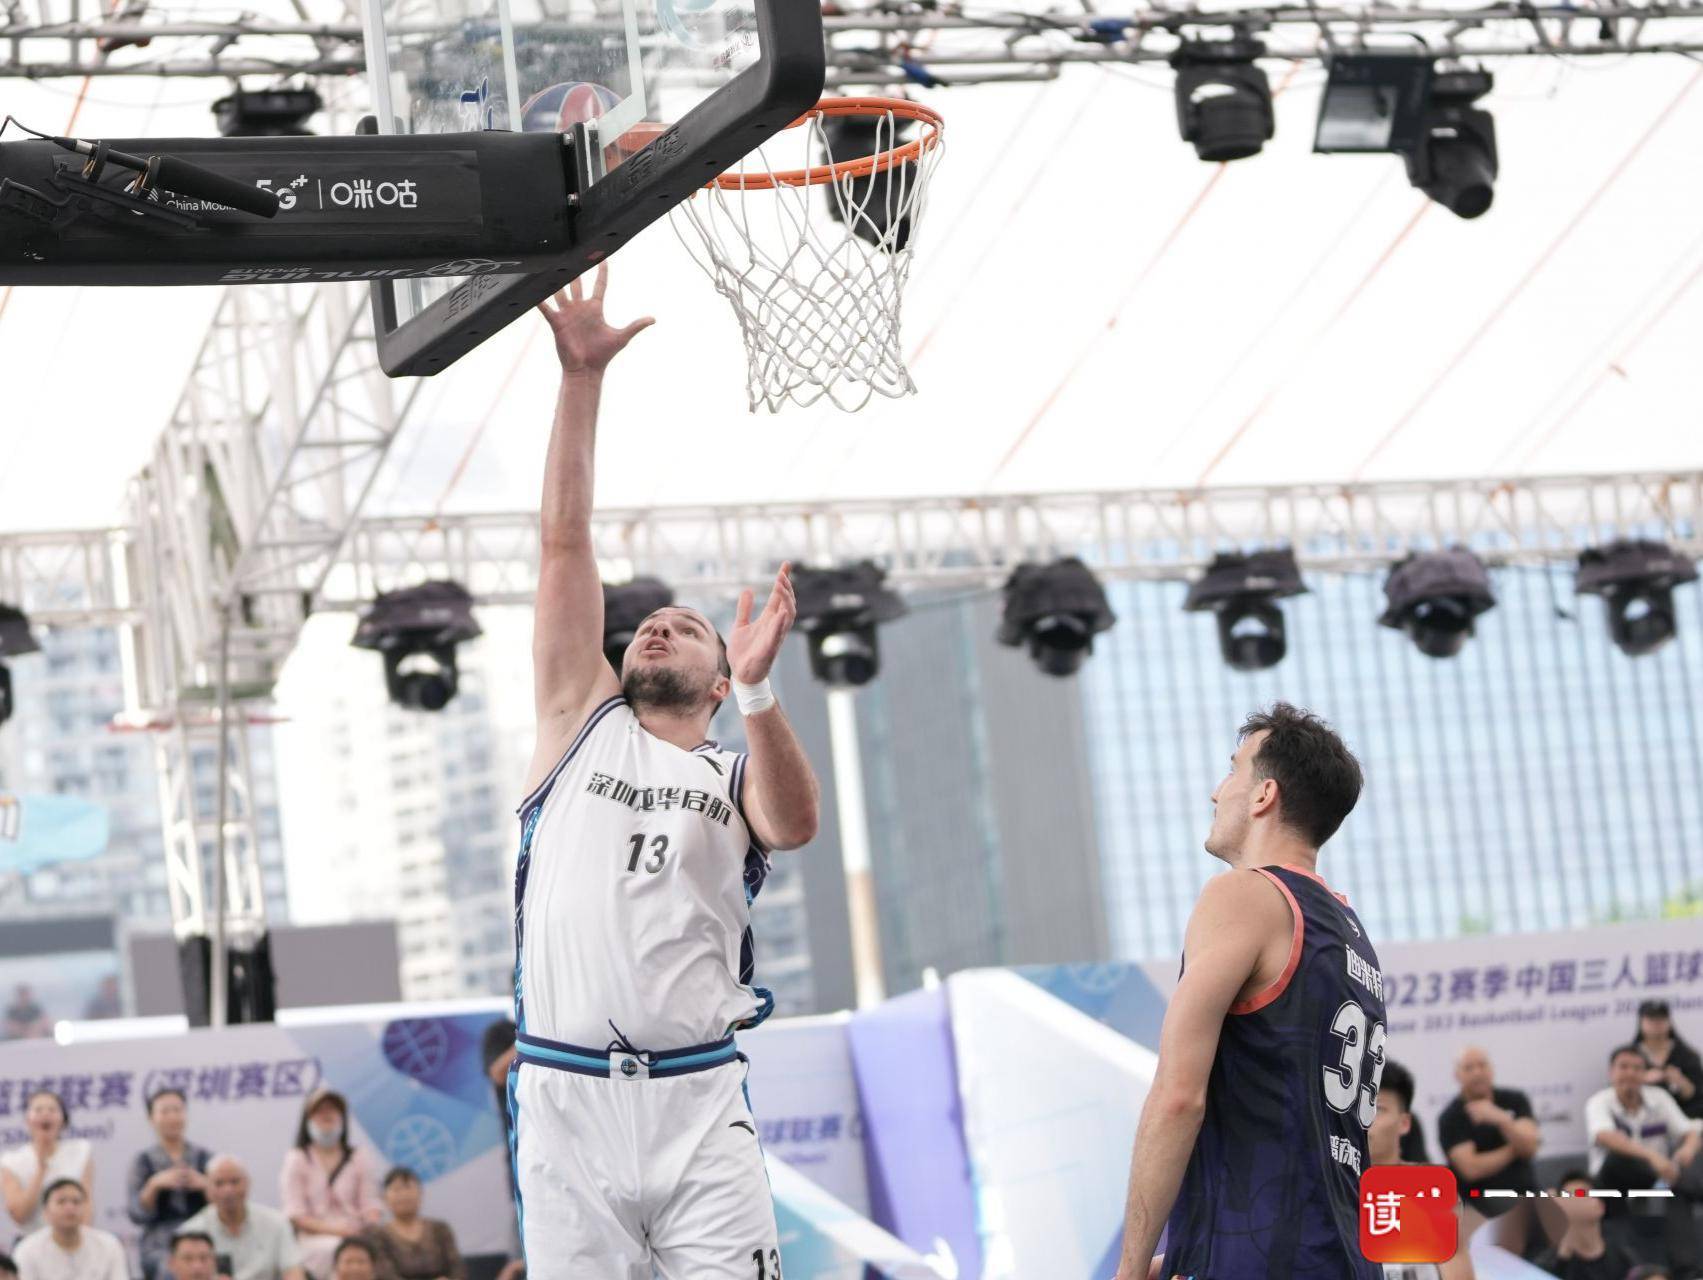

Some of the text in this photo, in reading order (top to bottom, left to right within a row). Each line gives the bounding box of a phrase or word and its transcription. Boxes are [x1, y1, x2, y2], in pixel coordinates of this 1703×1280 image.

[330, 179, 418, 209] 咪咕
[625, 832, 669, 874] 13
[1322, 1000, 1388, 1130] 33
[753, 1249, 781, 1280] 13
